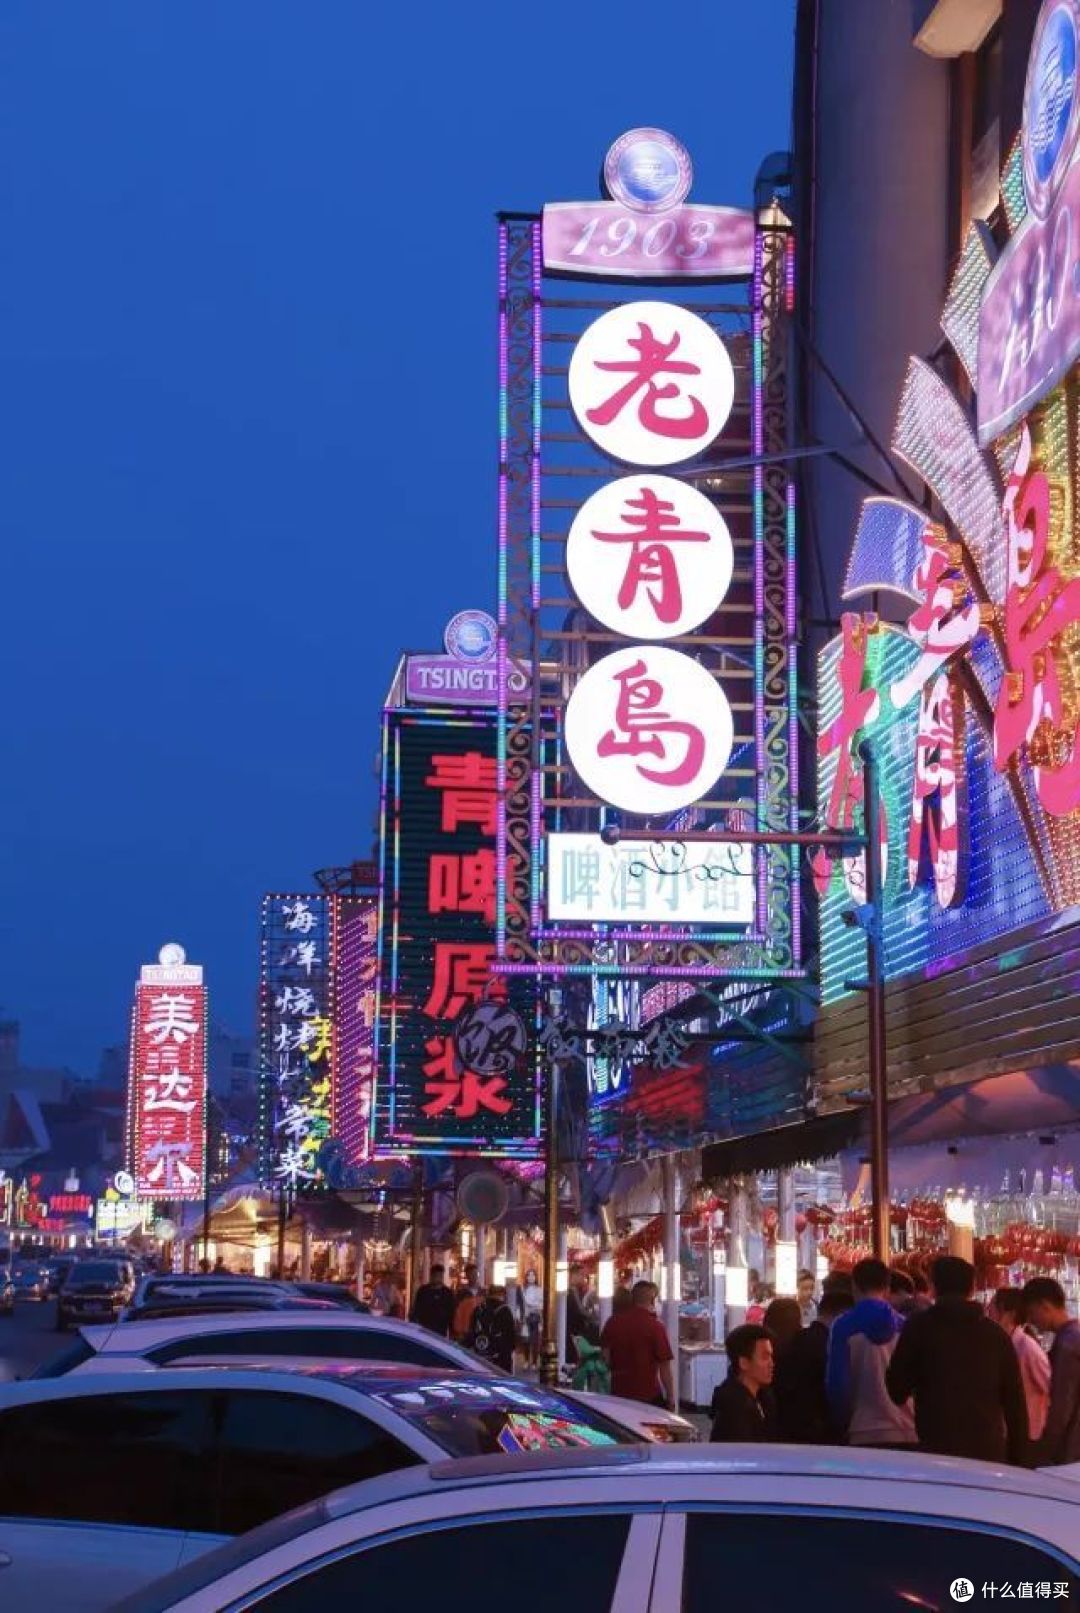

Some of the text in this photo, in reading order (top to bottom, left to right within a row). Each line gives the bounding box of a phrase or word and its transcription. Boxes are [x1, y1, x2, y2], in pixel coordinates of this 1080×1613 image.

[568, 215, 716, 260] 1903
[584, 321, 711, 787] 老青島
[424, 752, 516, 1119] 青啤原浆
[143, 993, 200, 1188] 美达尔
